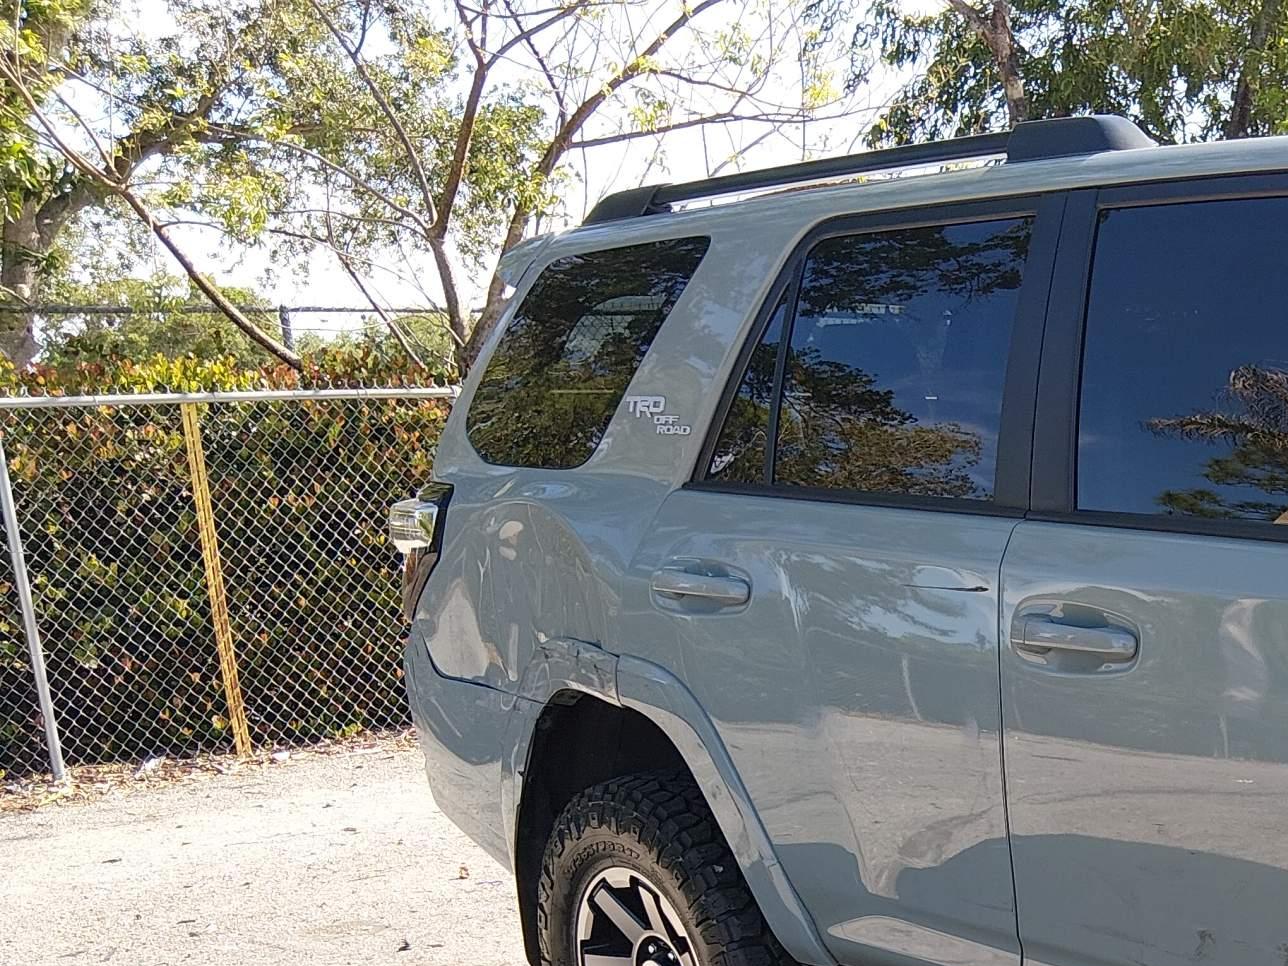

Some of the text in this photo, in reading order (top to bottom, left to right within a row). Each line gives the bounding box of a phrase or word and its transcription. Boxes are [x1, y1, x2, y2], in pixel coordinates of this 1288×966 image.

[626, 395, 666, 418] TRD
[653, 415, 680, 425] OFF
[656, 425, 691, 435] ROAD
